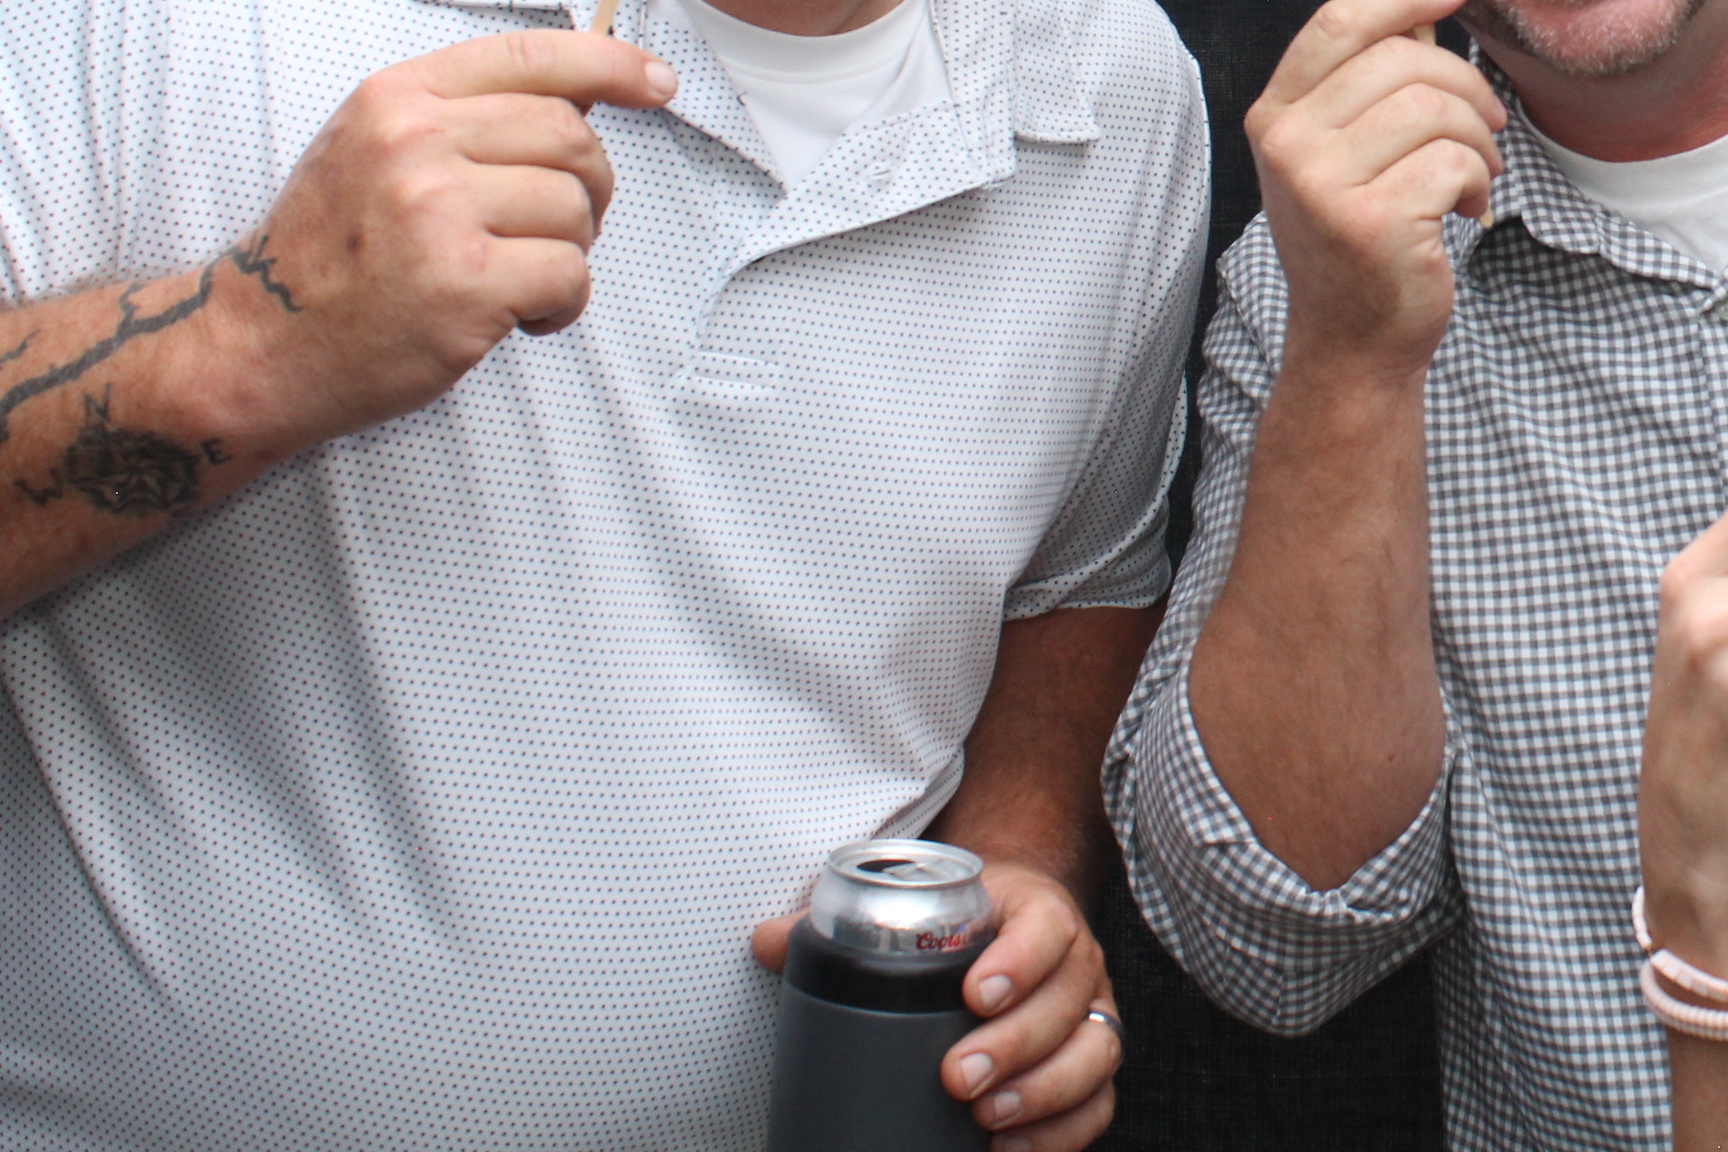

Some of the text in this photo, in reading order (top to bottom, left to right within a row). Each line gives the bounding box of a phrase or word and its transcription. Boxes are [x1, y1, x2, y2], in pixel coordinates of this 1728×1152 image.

[82, 383, 112, 425] N
[202, 437, 233, 466] E
[15, 468, 63, 507] W
[916, 931, 962, 950] Coors
